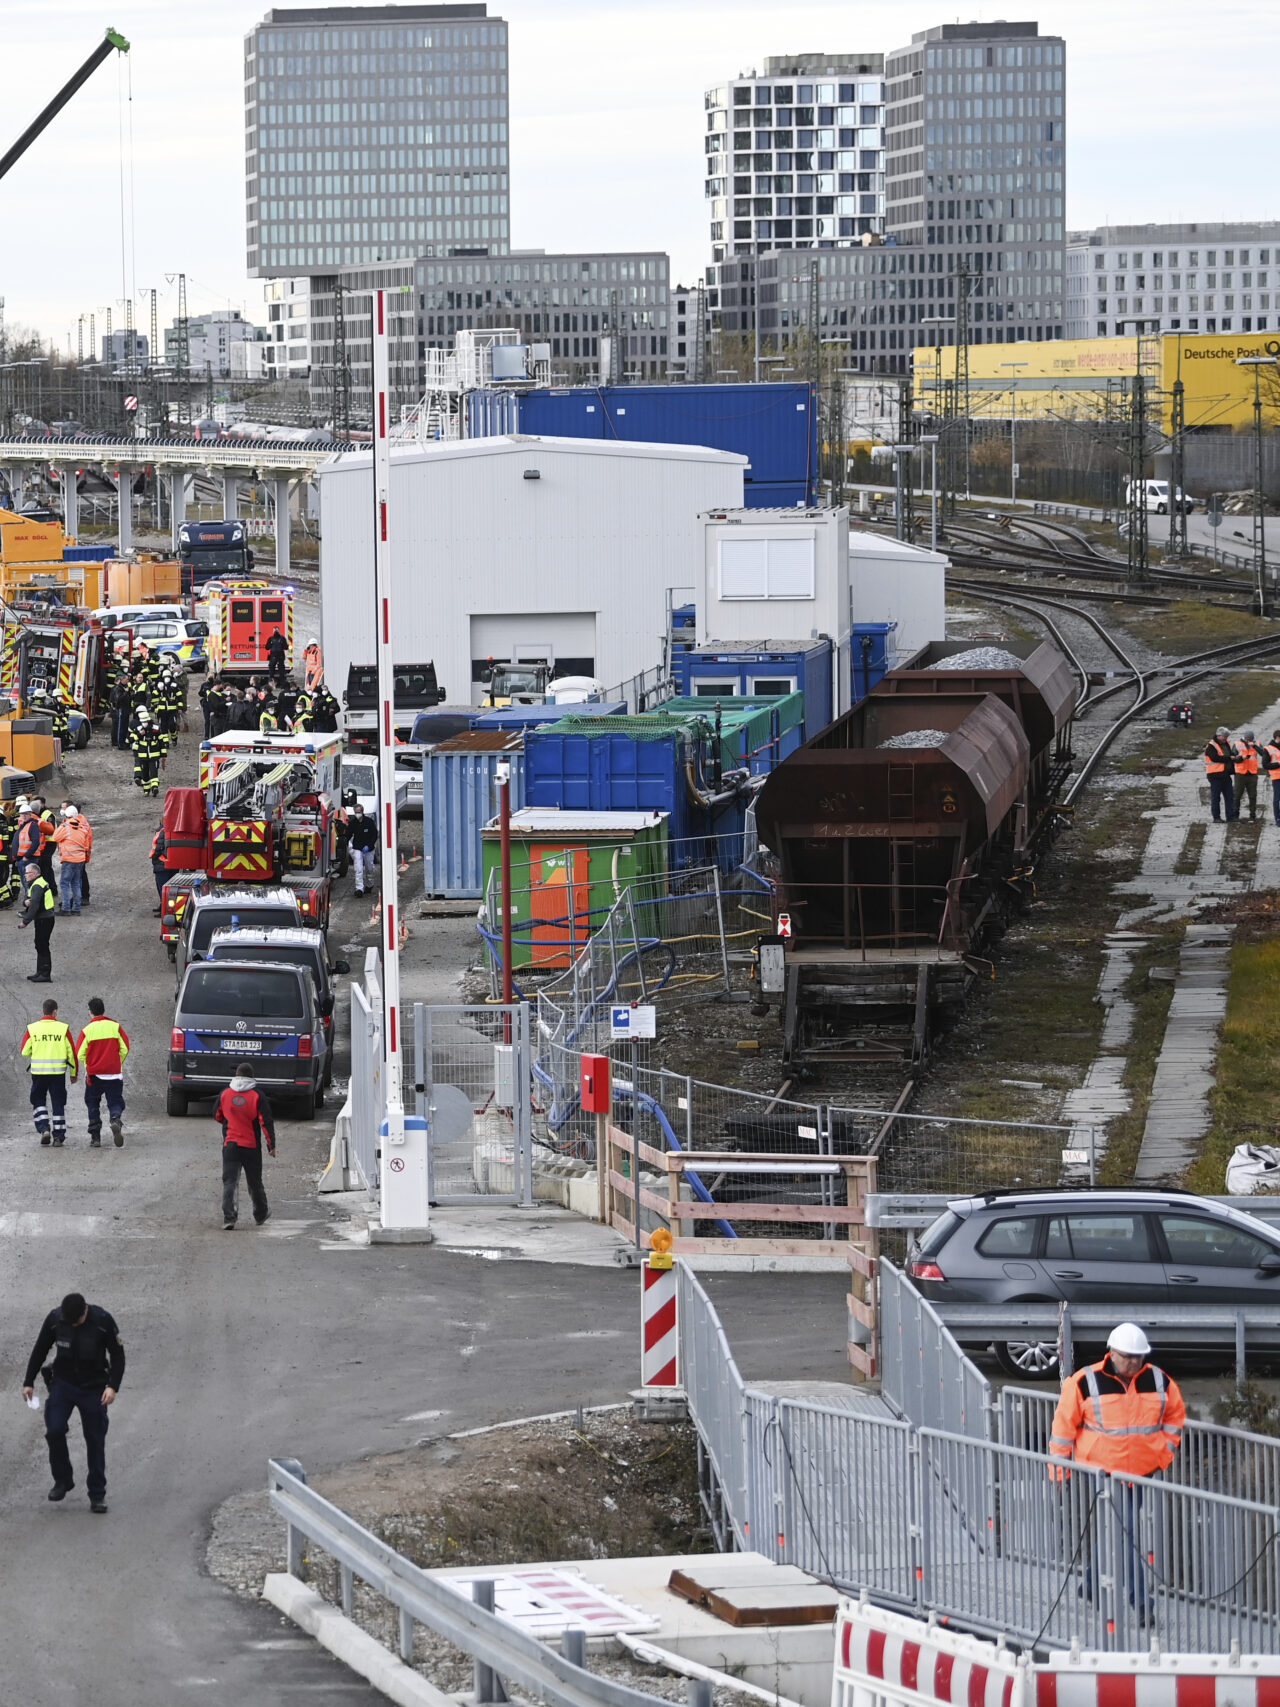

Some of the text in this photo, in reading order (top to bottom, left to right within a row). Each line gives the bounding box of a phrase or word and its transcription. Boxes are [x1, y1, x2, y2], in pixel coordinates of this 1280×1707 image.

[1184, 347, 1260, 360] Deutsche Post
[33, 1034, 62, 1042] 1. RTW
[224, 1040, 261, 1050] STA DA 123
